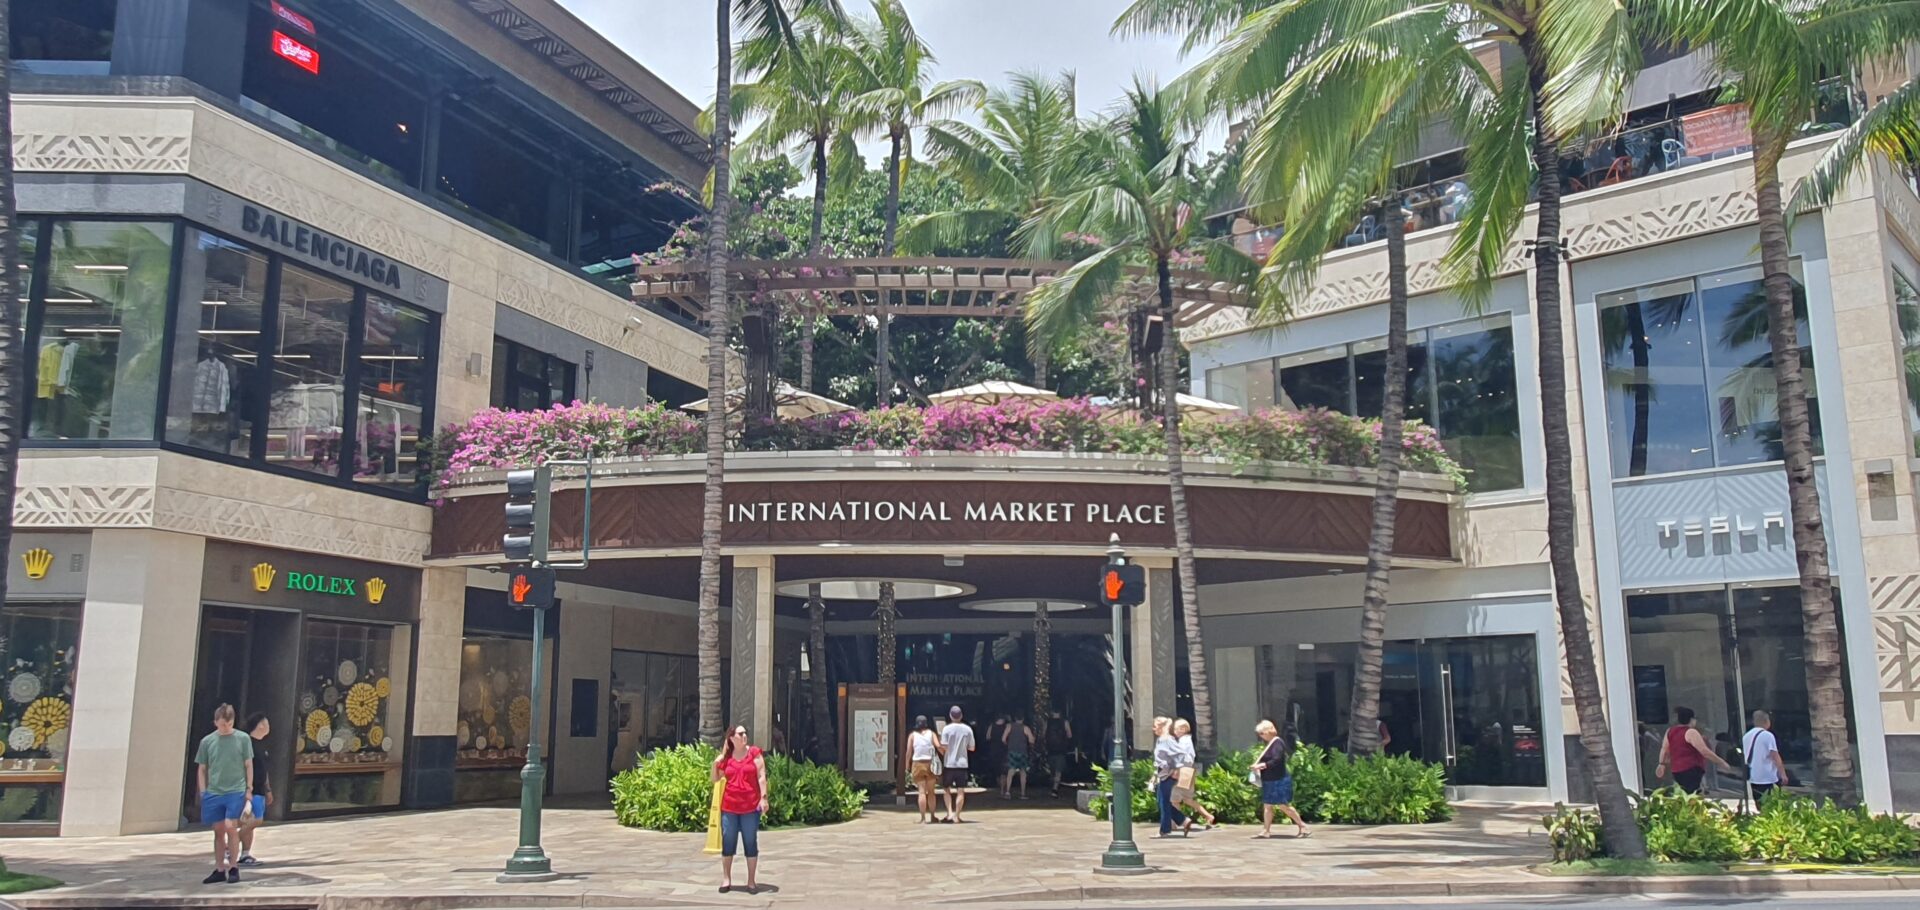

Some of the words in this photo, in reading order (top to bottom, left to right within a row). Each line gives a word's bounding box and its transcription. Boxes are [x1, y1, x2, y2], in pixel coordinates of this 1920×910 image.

[242, 205, 401, 290] BALENCIAGA
[729, 501, 952, 523] INTERNATIONAL
[964, 502, 1075, 522] MARKET
[1086, 503, 1166, 524] PLACE
[1656, 511, 1785, 538] TESLA
[287, 571, 357, 596] ROLEX
